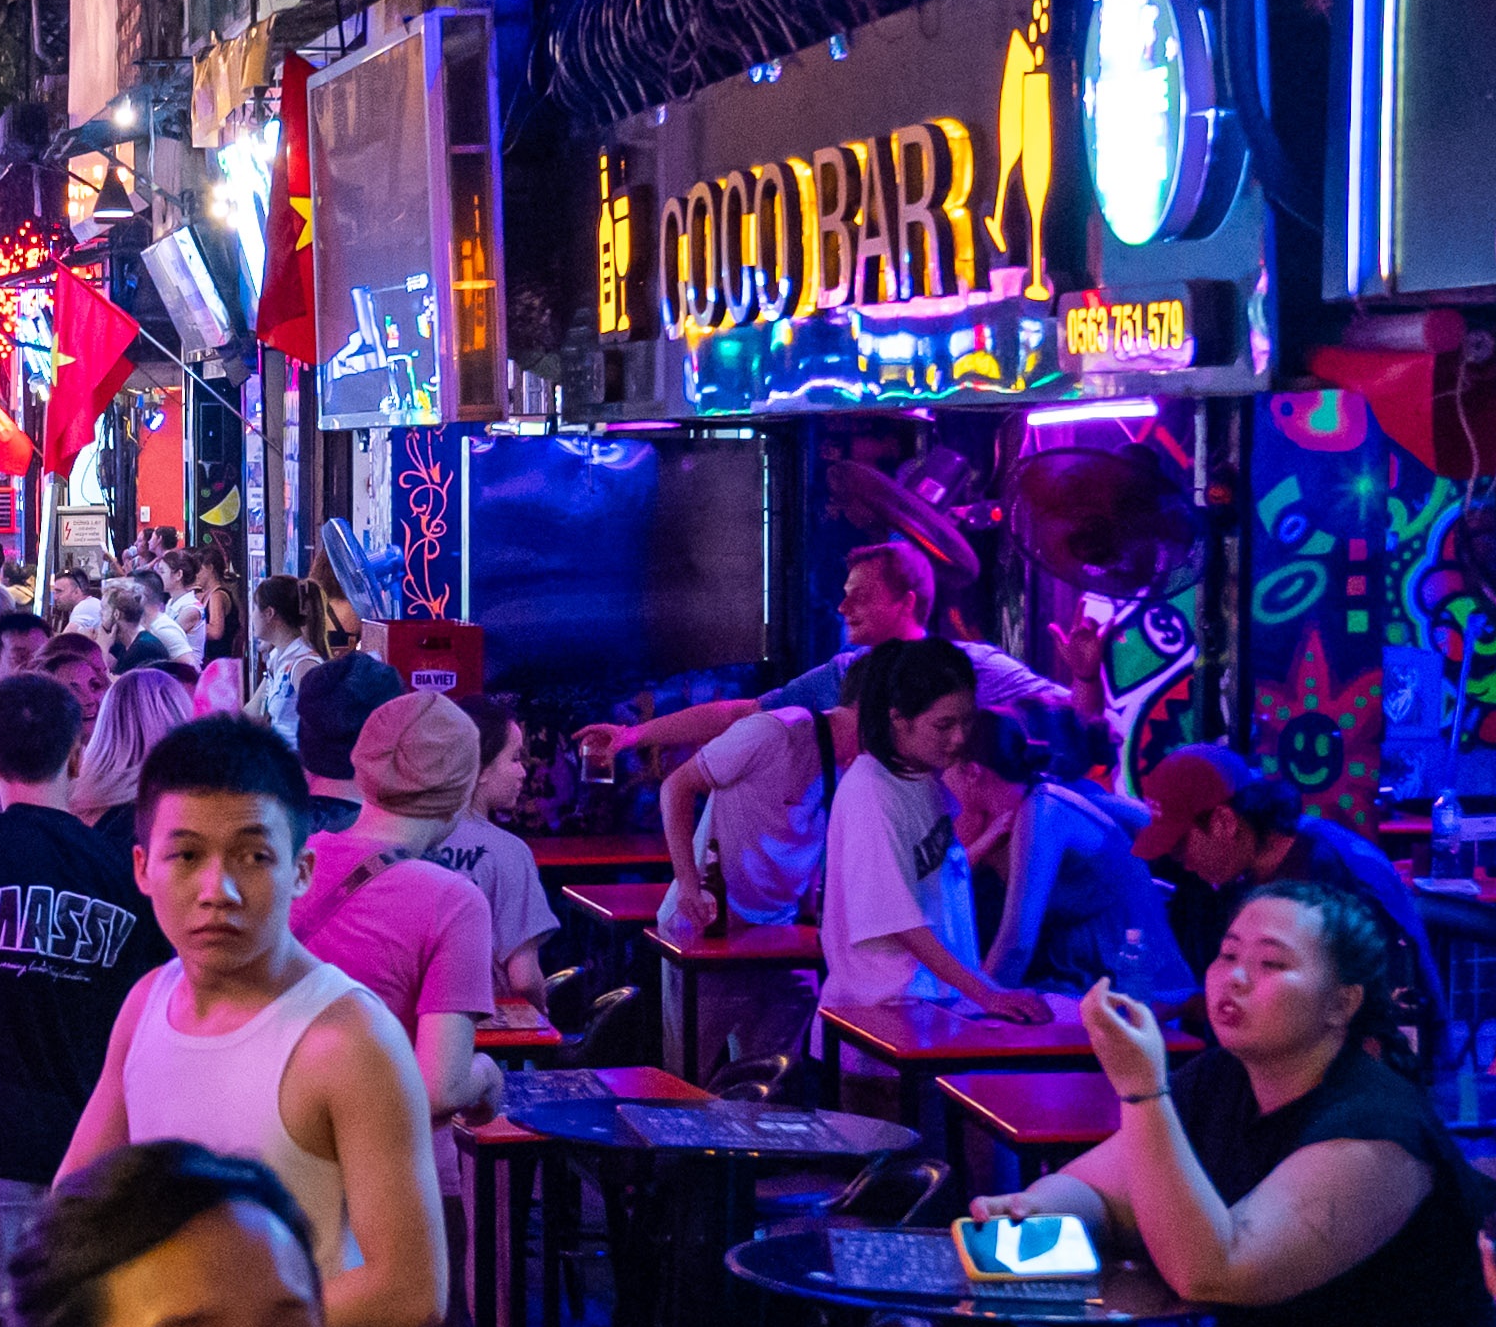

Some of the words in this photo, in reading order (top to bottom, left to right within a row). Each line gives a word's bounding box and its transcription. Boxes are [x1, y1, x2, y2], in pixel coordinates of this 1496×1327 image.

[660, 157, 816, 341] COCO
[815, 118, 974, 310] BAR
[1067, 307, 1109, 354] 0563
[1111, 304, 1143, 352] 751
[1147, 300, 1184, 350] 579
[415, 674, 432, 685] BIA
